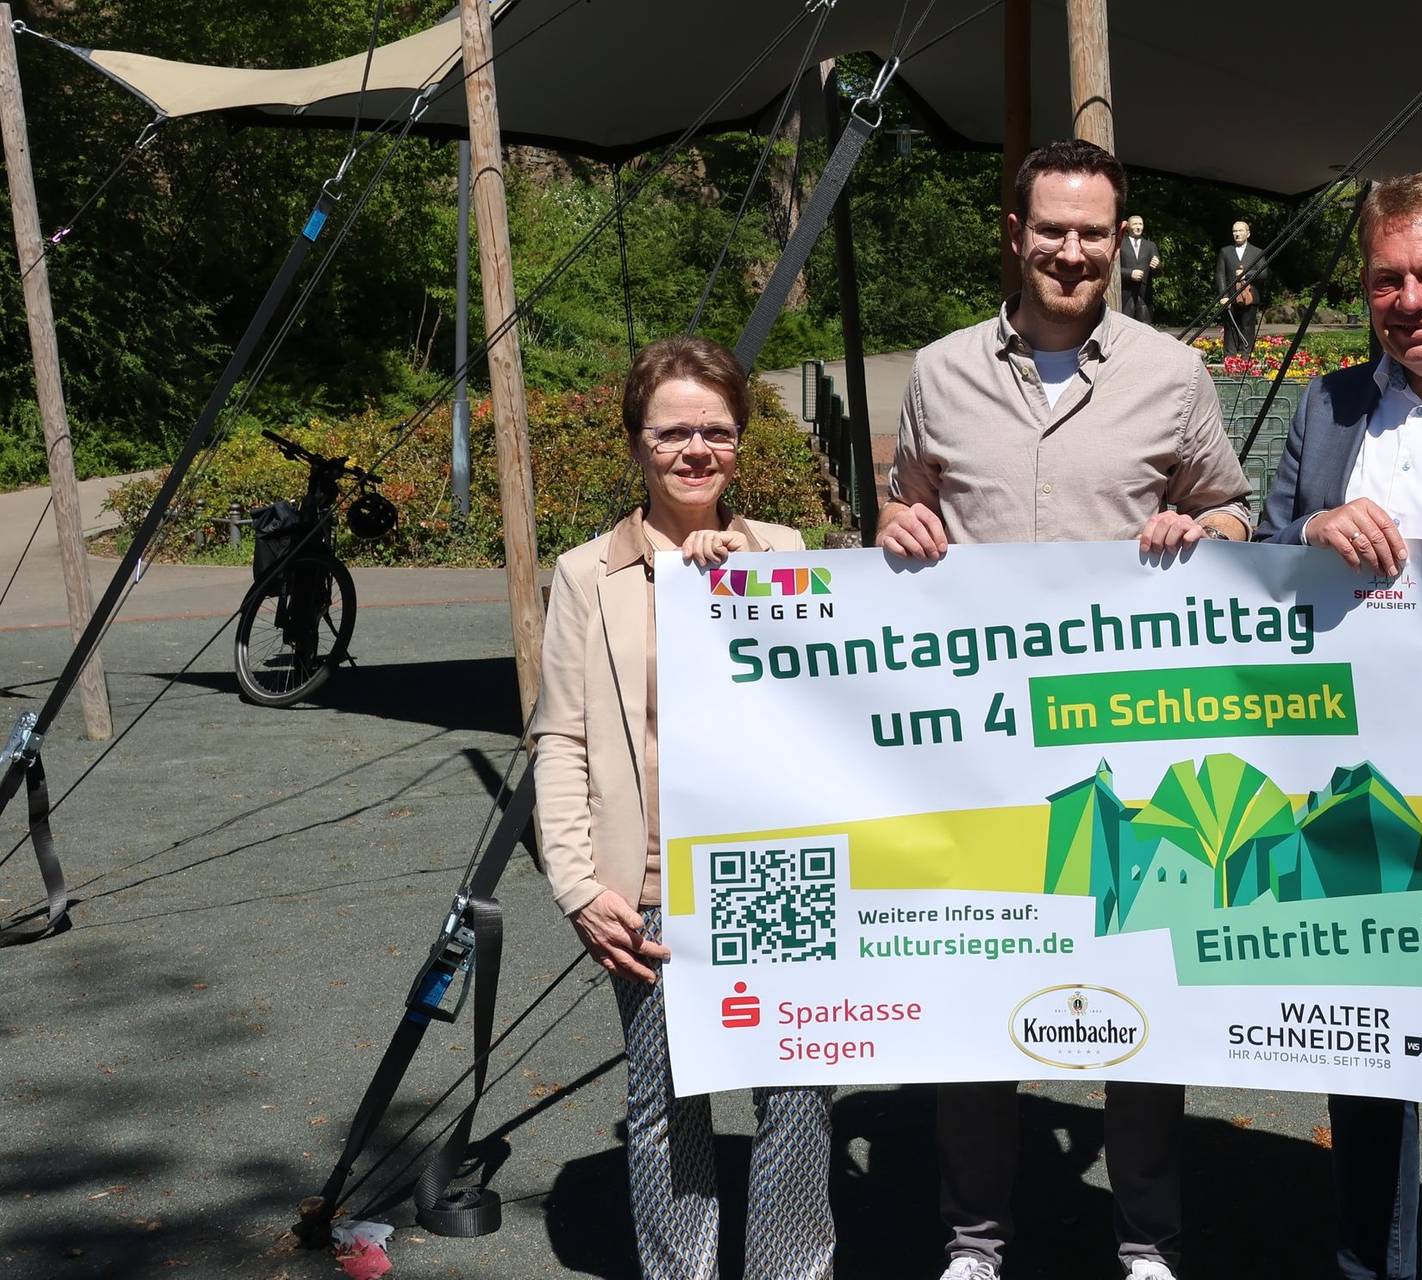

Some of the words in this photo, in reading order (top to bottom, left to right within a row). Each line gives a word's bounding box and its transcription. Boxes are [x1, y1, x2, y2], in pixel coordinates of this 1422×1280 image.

[1354, 589, 1403, 600] SIEGEN
[1366, 601, 1417, 610] PULSIERT
[710, 602, 834, 620] SIEGEN
[728, 596, 1315, 683] Sonntagnachmittag
[871, 708, 963, 748] um
[984, 692, 1017, 737] 4
[1047, 696, 1097, 730] im
[1110, 684, 1346, 729] Schlosspark
[858, 907, 938, 926] Weitere
[945, 905, 995, 923] Infos
[1001, 904, 1039, 921] auf:
[859, 932, 1074, 961] kultursiegen.de
[1196, 921, 1349, 963] Eintritt
[777, 998, 922, 1029] Sparkasse
[1280, 1002, 1391, 1029] WALTER
[1023, 1018, 1137, 1044] Krombacher
[1228, 1024, 1391, 1055] SCHNEIDER
[778, 1039, 875, 1065] Siegen
[1229, 1049, 1250, 1060] IHR
[1253, 1051, 1330, 1065] AUTOHAUS.
[1333, 1056, 1360, 1067] SEIT
[1364, 1057, 1391, 1069] 1958
[1407, 1042, 1420, 1051] WS
